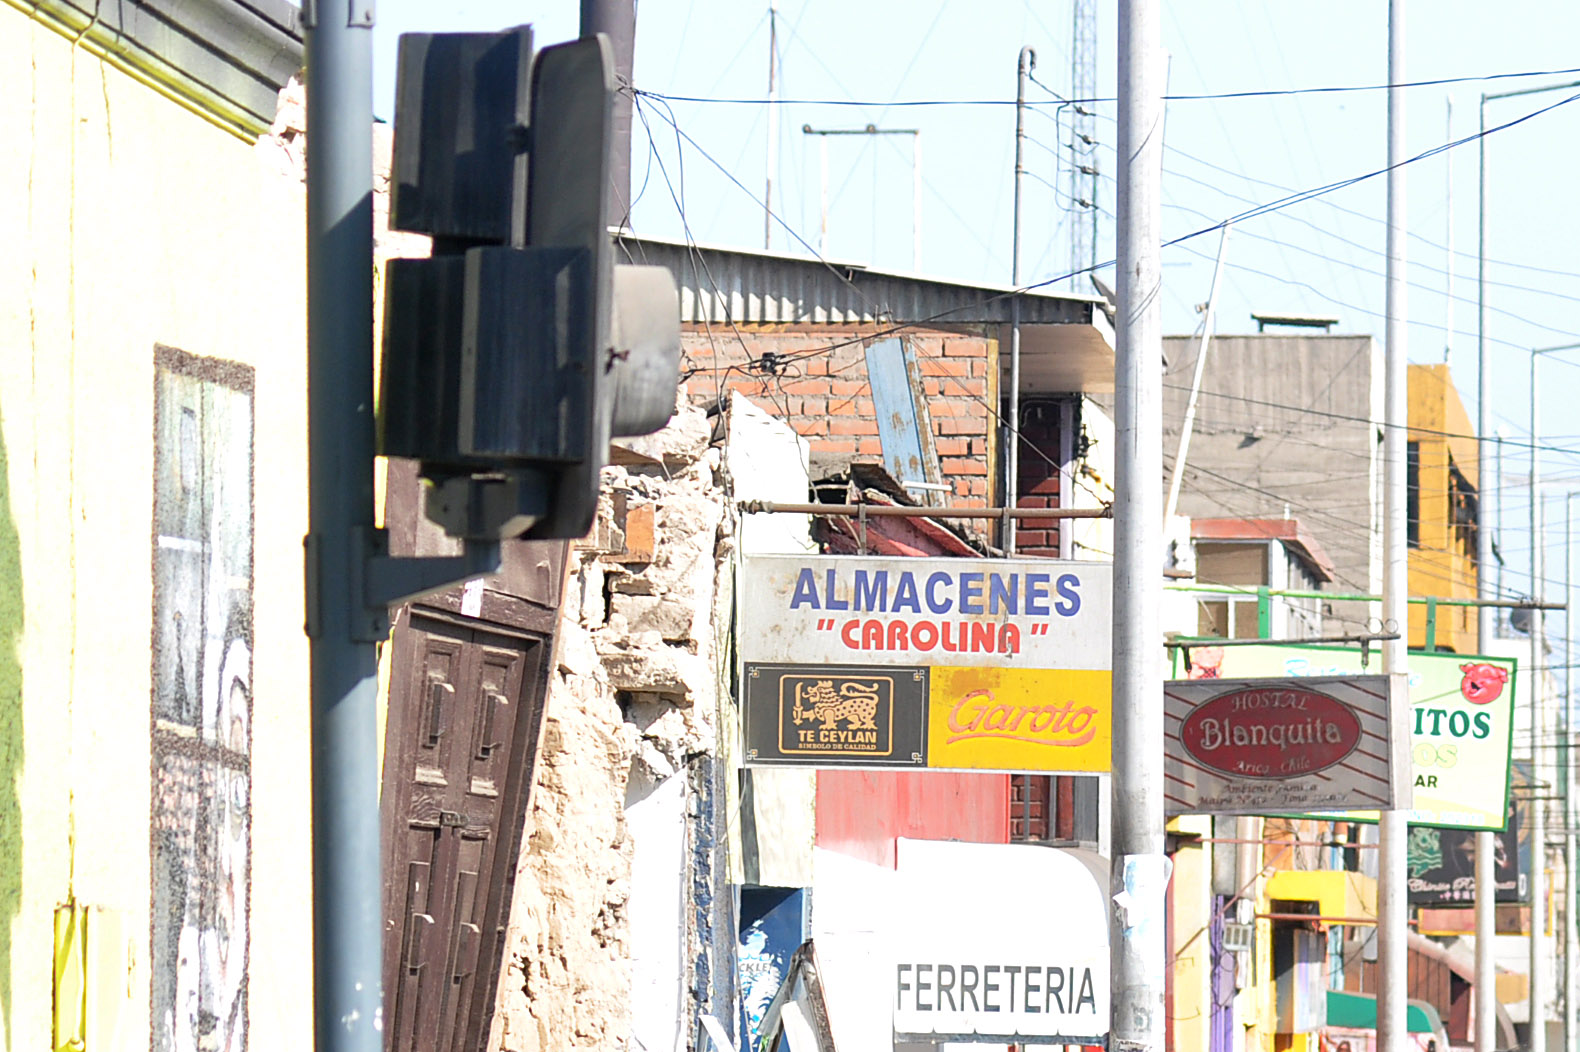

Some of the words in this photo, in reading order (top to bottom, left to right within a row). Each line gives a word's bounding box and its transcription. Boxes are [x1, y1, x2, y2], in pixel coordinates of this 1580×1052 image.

[790, 567, 1082, 617] ALMACENES
[947, 688, 1098, 738] Garoto
[1231, 692, 1311, 713] HOSTAL
[798, 730, 817, 743] TE
[820, 730, 877, 744] CEYLAN
[1199, 717, 1342, 750] Blanquita
[1413, 707, 1491, 739] ITOS
[844, 743, 877, 751] CALIDAD
[1280, 756, 1311, 774] Chile
[897, 963, 1096, 1015] FERRETERIA
